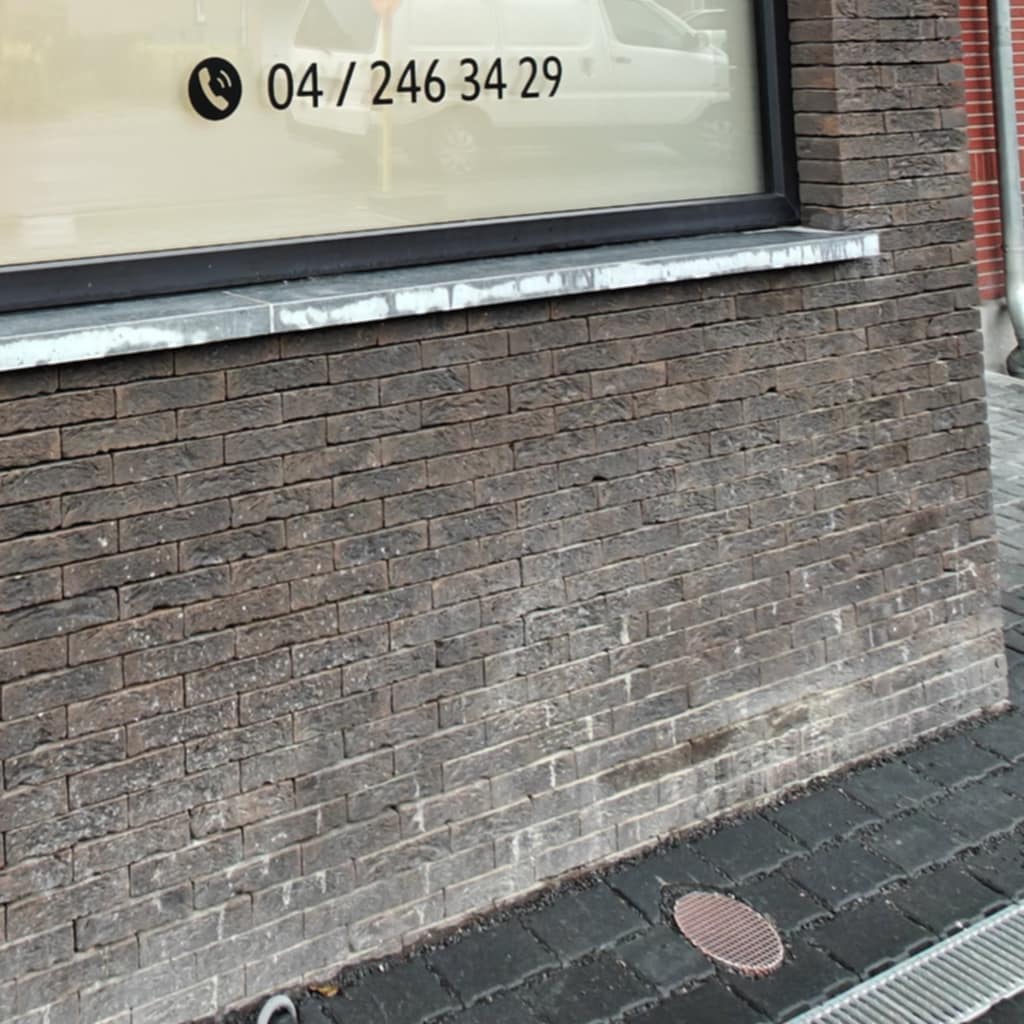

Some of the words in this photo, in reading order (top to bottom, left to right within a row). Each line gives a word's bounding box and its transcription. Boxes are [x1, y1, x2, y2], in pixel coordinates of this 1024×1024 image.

[267, 62, 325, 111] 04
[370, 59, 447, 106] 246
[459, 57, 508, 102] 34
[519, 55, 563, 99] 29
